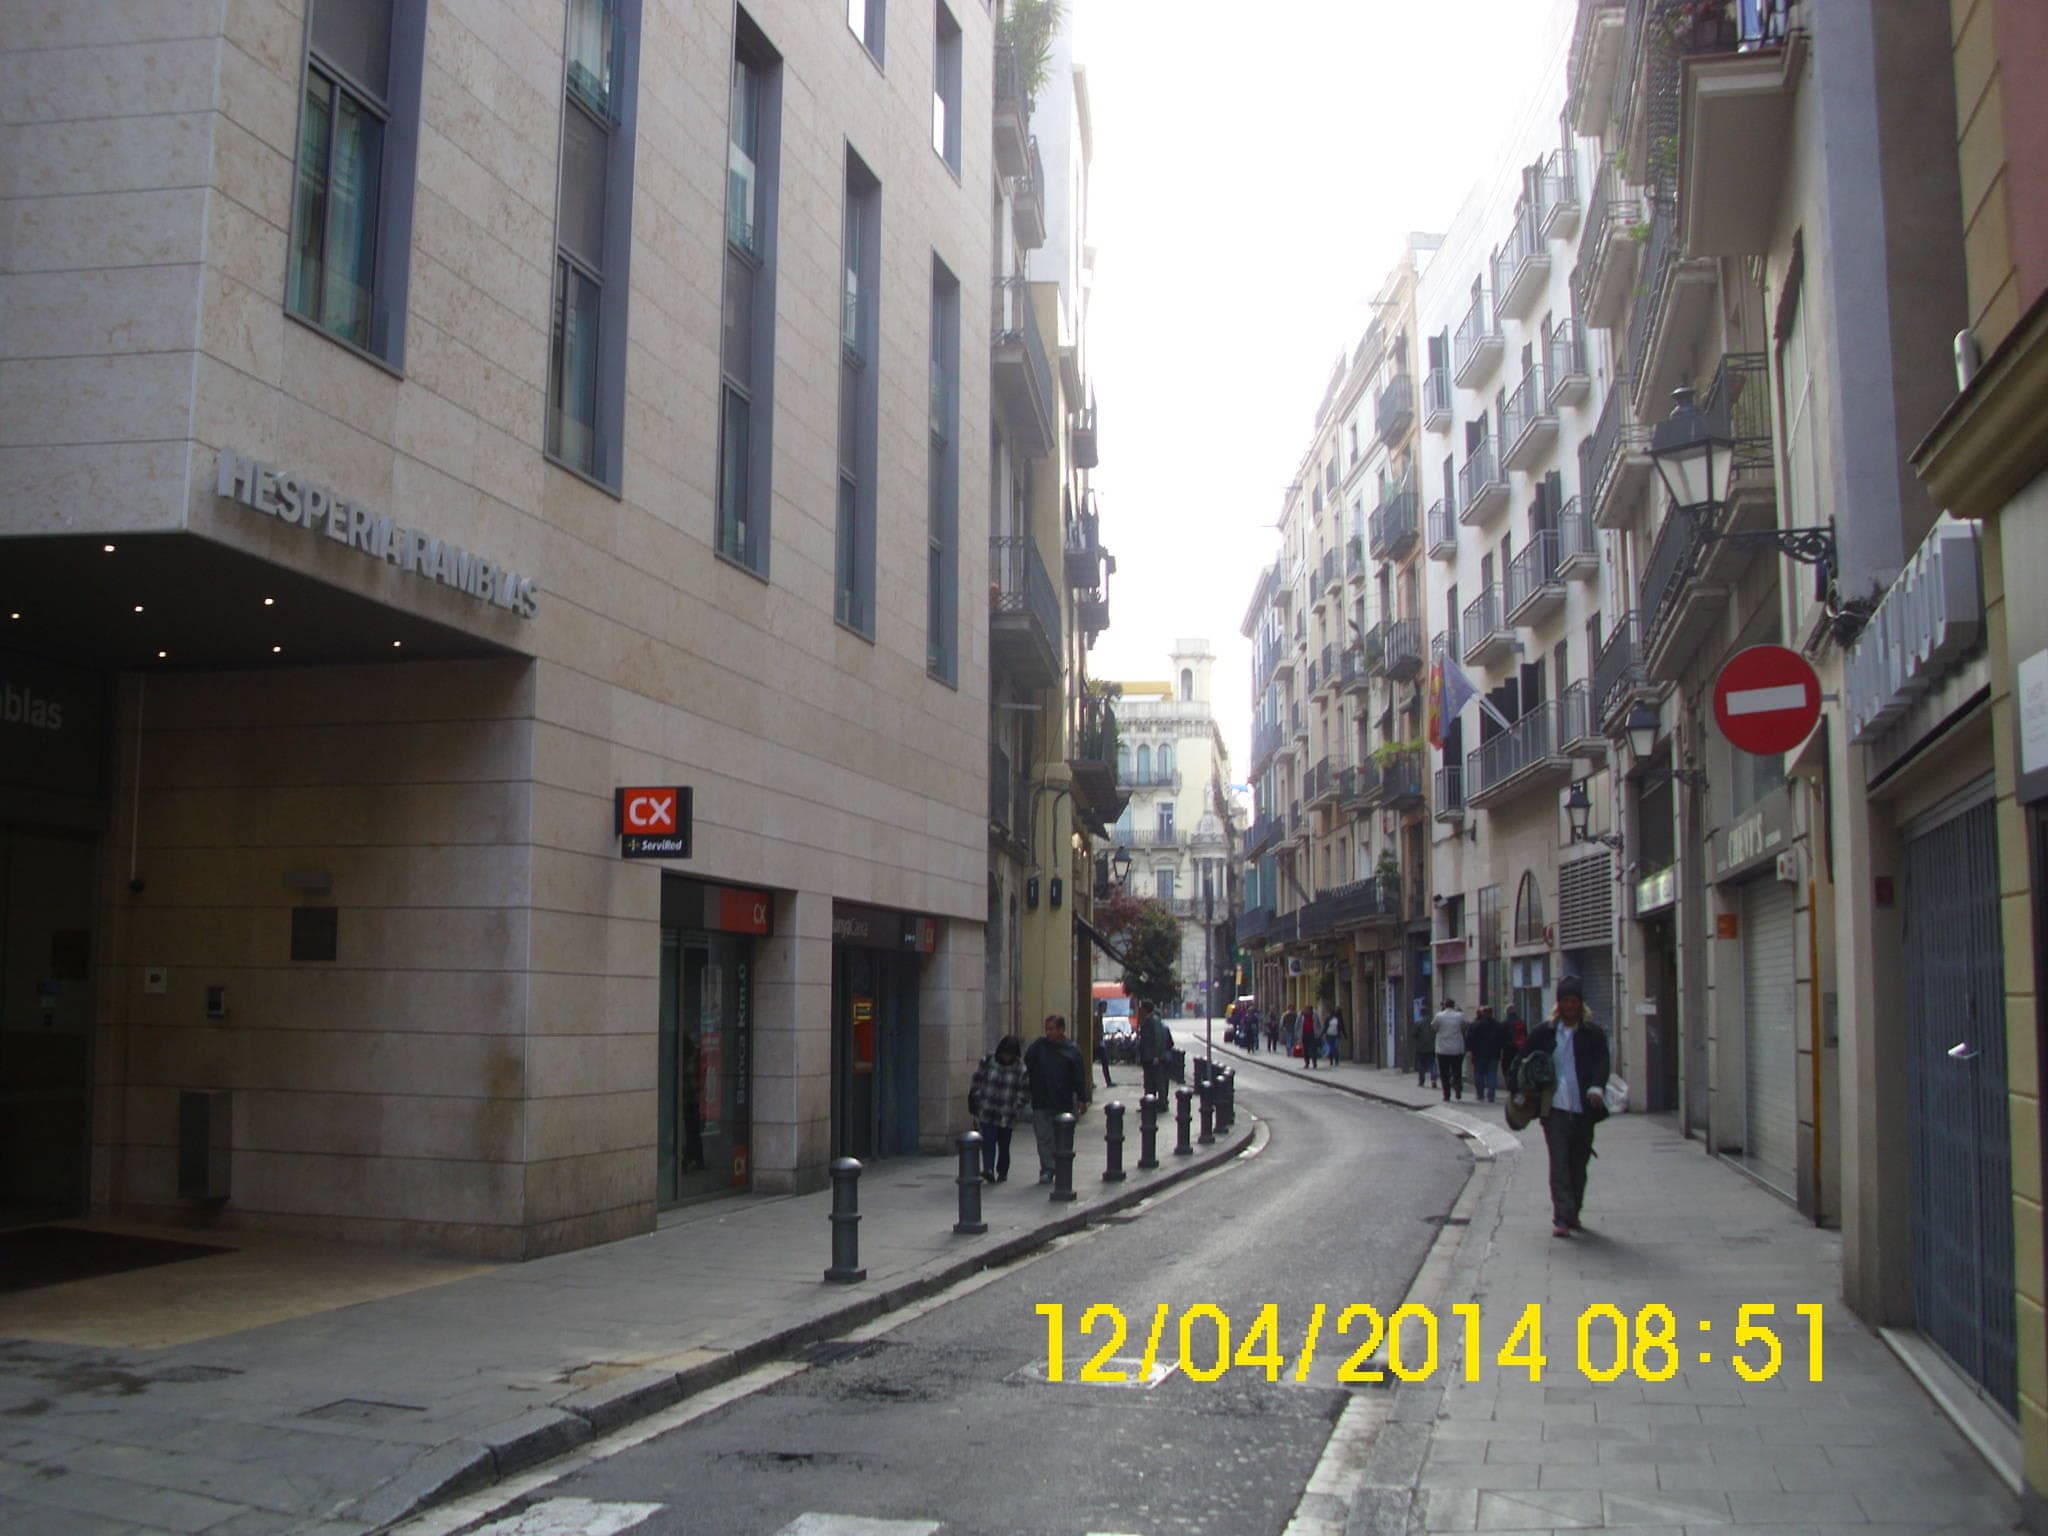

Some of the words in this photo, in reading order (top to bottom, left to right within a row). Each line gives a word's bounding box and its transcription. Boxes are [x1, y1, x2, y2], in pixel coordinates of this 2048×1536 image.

[216, 450, 401, 565] HESPERIA
[400, 527, 541, 619] RAMBLAS
[0, 679, 64, 732] blas
[628, 796, 672, 826] CX
[641, 839, 683, 851] ServiRed
[753, 904, 767, 924] CX
